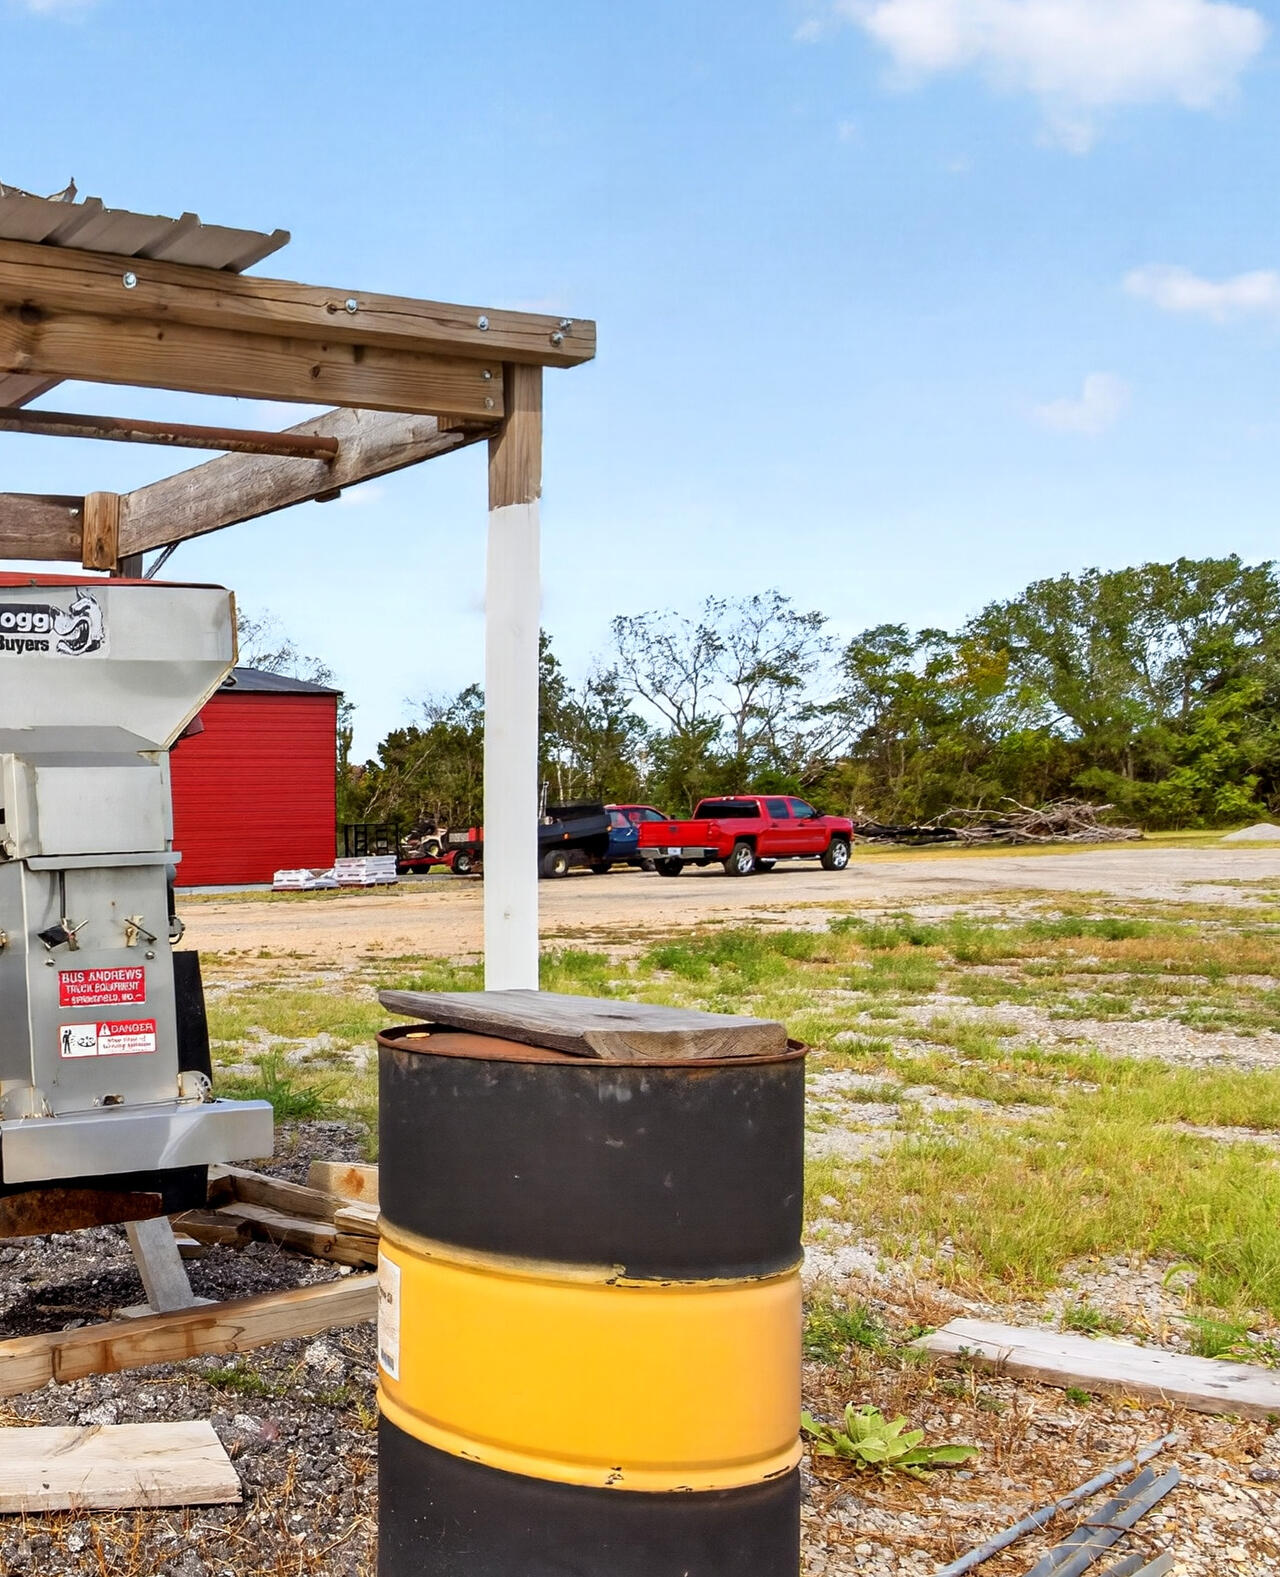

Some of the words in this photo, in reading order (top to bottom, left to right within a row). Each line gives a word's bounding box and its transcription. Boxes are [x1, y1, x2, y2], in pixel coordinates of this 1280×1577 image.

[62, 972, 84, 983] BUS
[88, 969, 142, 981] ANDREWS
[66, 984, 93, 993] TRUCK
[95, 981, 139, 992] EQUIPMENT
[111, 1023, 154, 1033] DANGER
